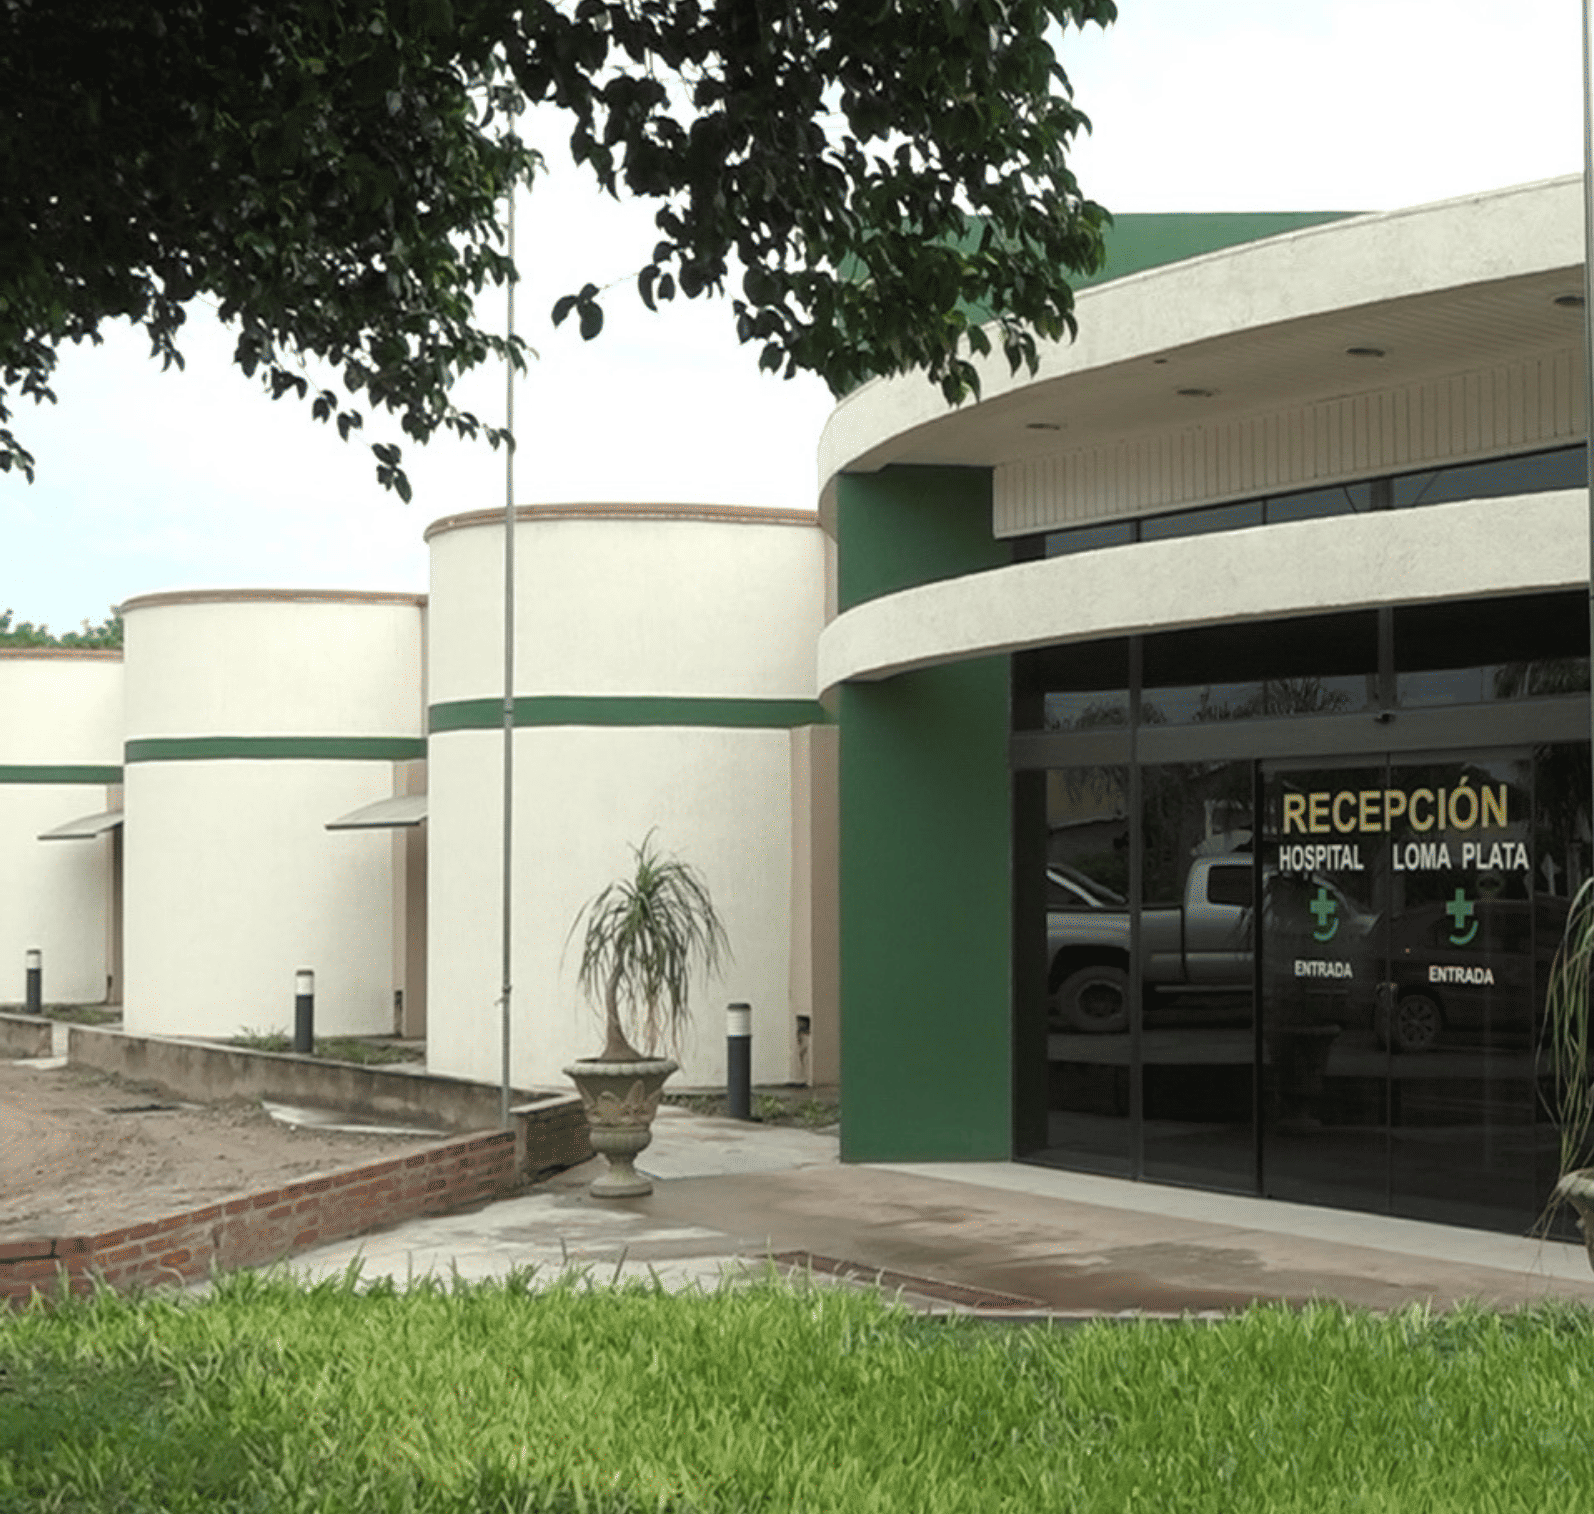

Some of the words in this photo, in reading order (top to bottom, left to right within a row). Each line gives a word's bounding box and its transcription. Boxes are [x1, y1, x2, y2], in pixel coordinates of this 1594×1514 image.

[1282, 775, 1508, 835] RECEPCIÓN
[1279, 844, 1365, 872] HOSPITAL
[1392, 842, 1452, 871] LOMA
[1461, 842, 1530, 871] PLATA
[1294, 959, 1353, 979] ENTRADA
[1428, 964, 1495, 986] ENTRADA
